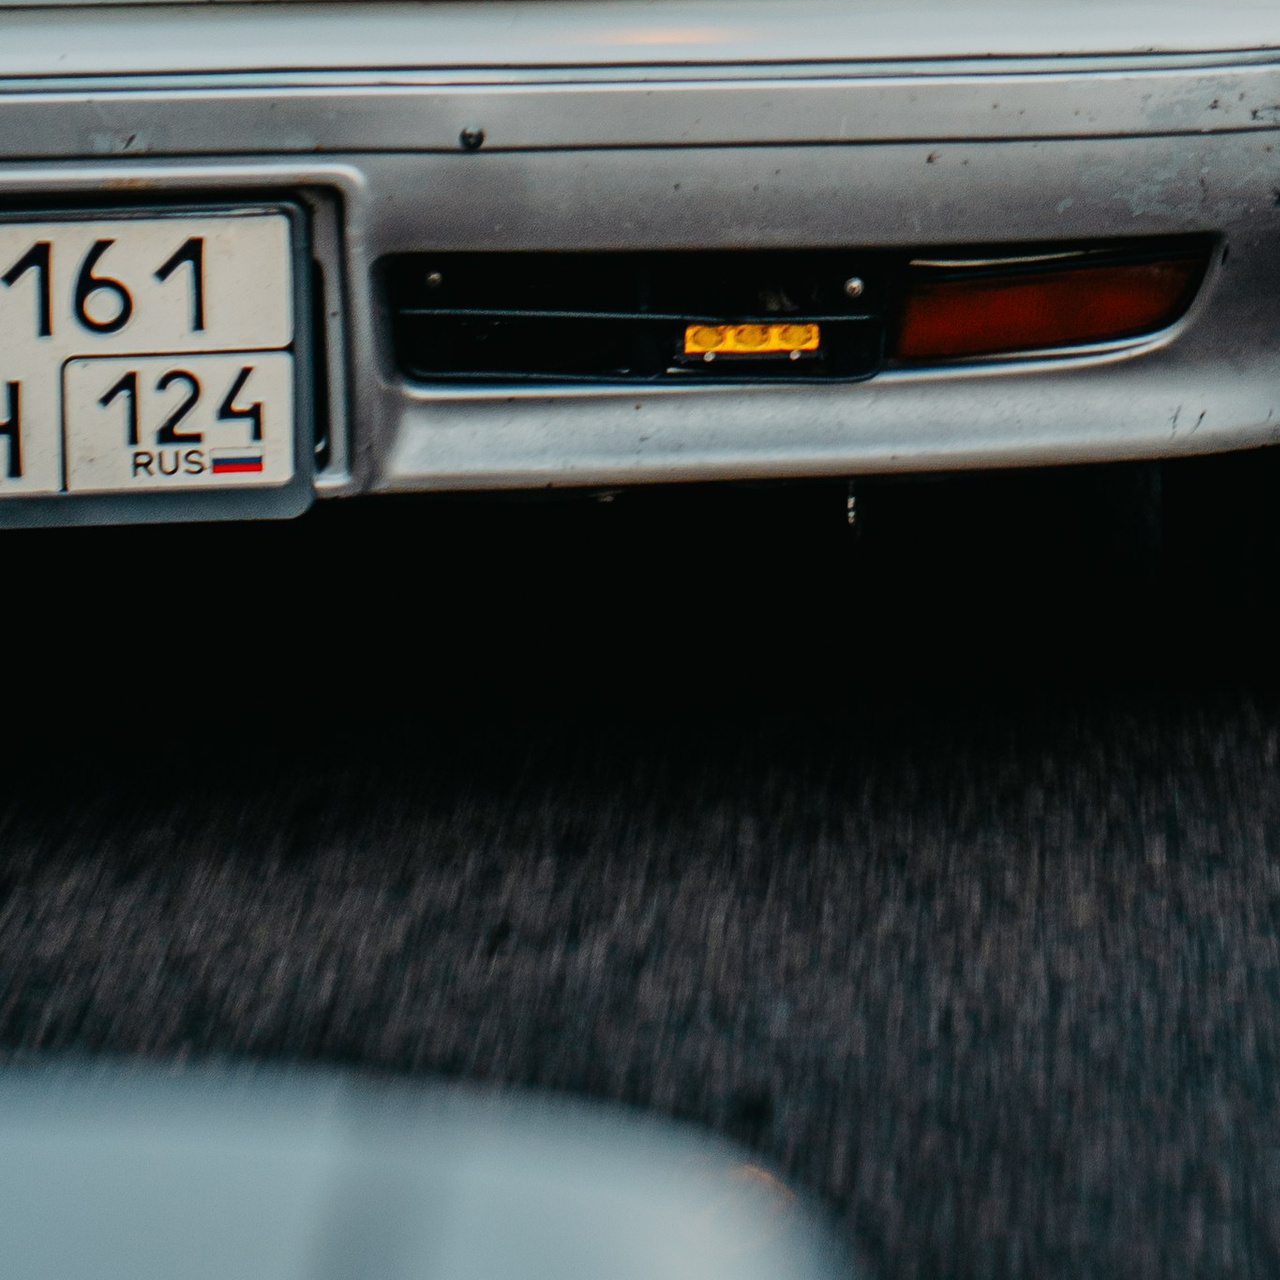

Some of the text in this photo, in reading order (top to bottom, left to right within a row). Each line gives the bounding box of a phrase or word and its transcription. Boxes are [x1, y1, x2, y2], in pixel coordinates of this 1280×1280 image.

[1, 236, 205, 337] 161
[98, 366, 263, 446] 124
[132, 449, 206, 478] RUS
